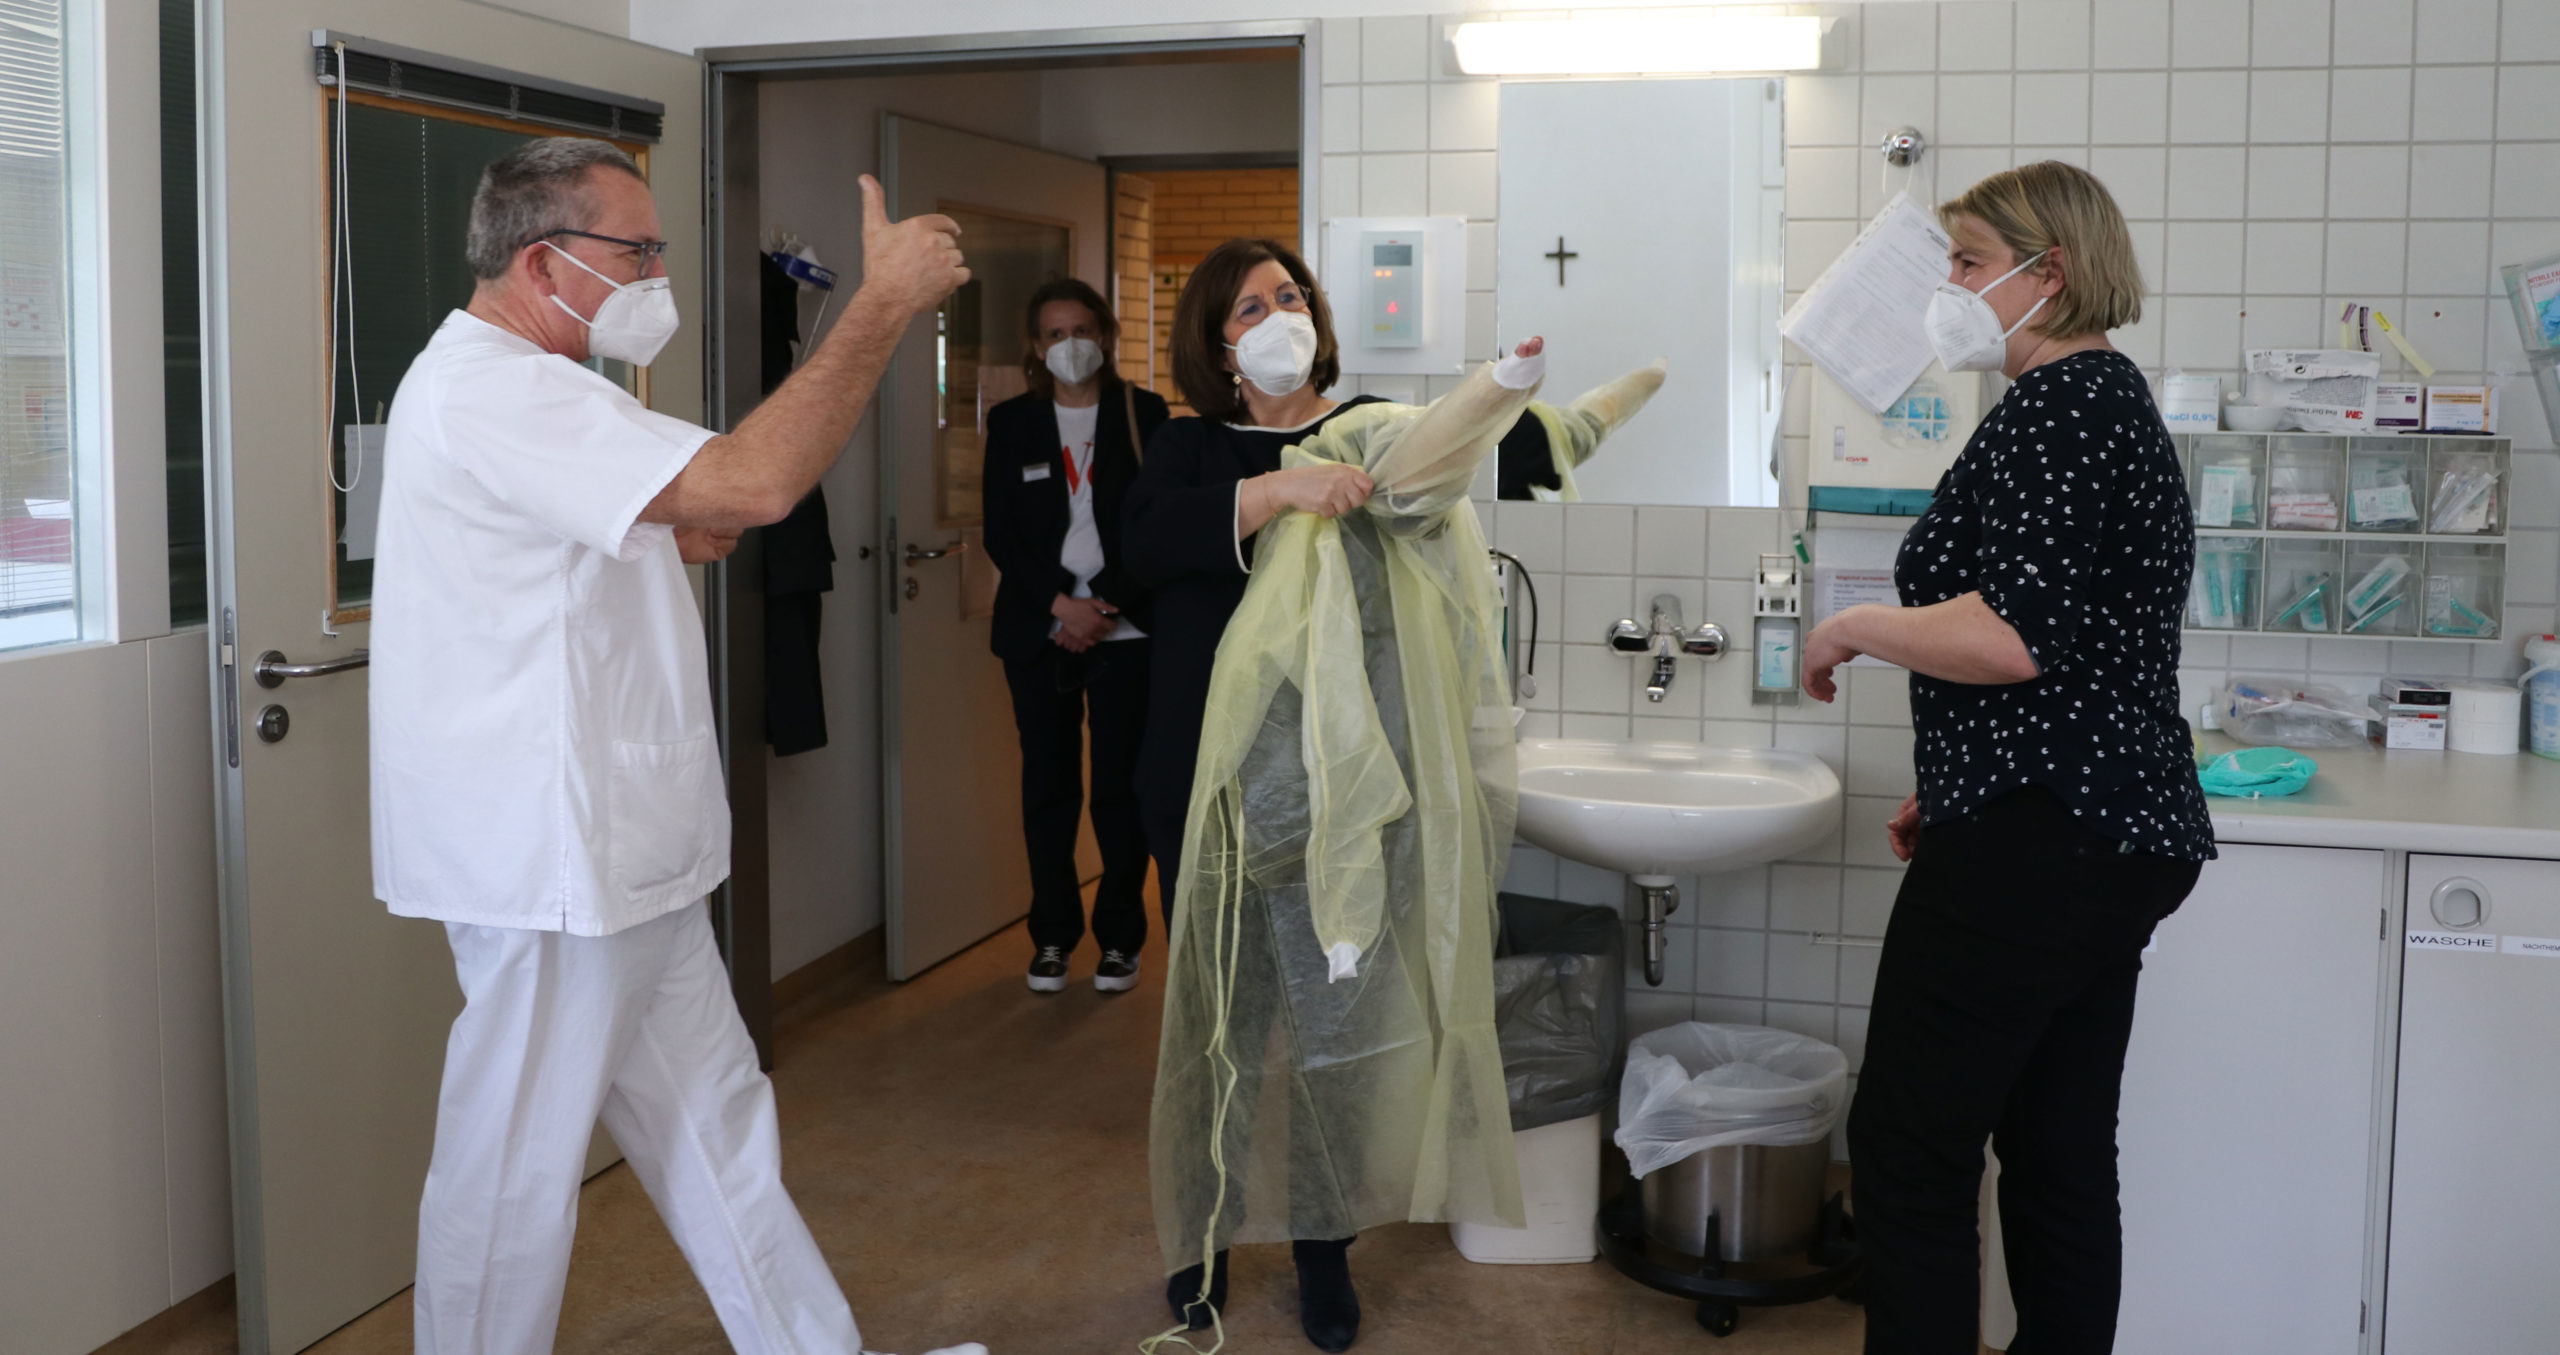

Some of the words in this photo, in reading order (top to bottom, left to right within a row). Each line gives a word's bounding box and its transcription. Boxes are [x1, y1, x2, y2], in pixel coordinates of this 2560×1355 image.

[2165, 412, 2190, 421] NaCl
[2192, 412, 2217, 422] 0,9%
[2345, 409, 2364, 420] 3M
